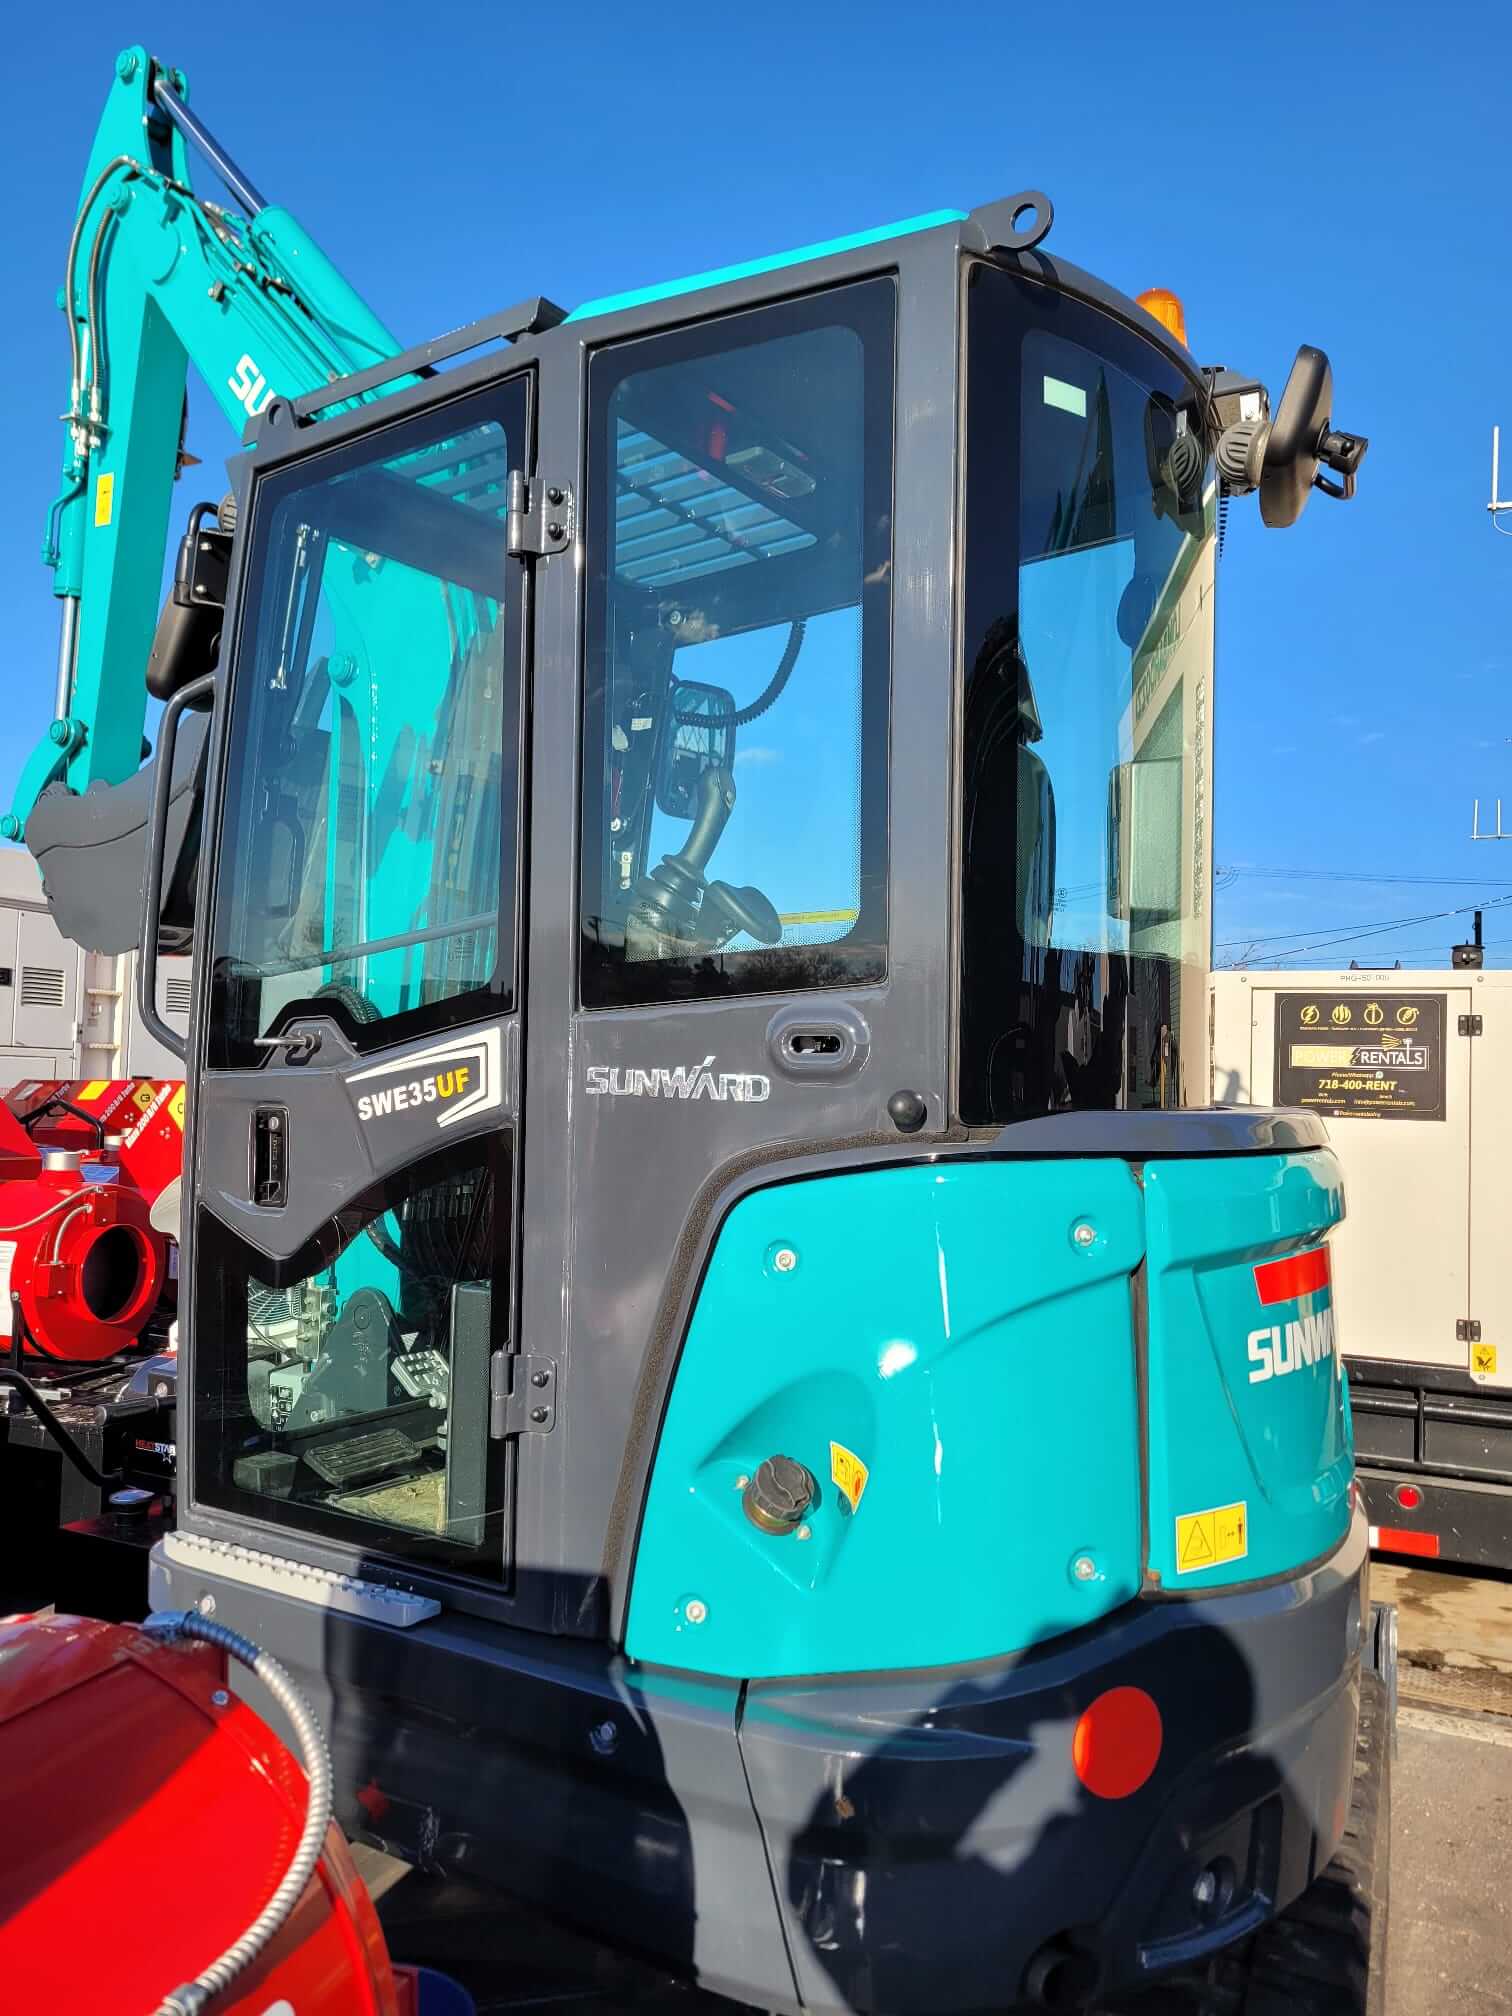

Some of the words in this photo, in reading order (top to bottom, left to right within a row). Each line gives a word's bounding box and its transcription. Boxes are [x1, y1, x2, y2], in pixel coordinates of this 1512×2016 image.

[1361, 1050, 1423, 1065] RENTALS
[358, 1067, 471, 1121] SWE35UF
[1318, 1079, 1398, 1091] 718-400-RENT
[1247, 1308, 1335, 1384] SUNW
